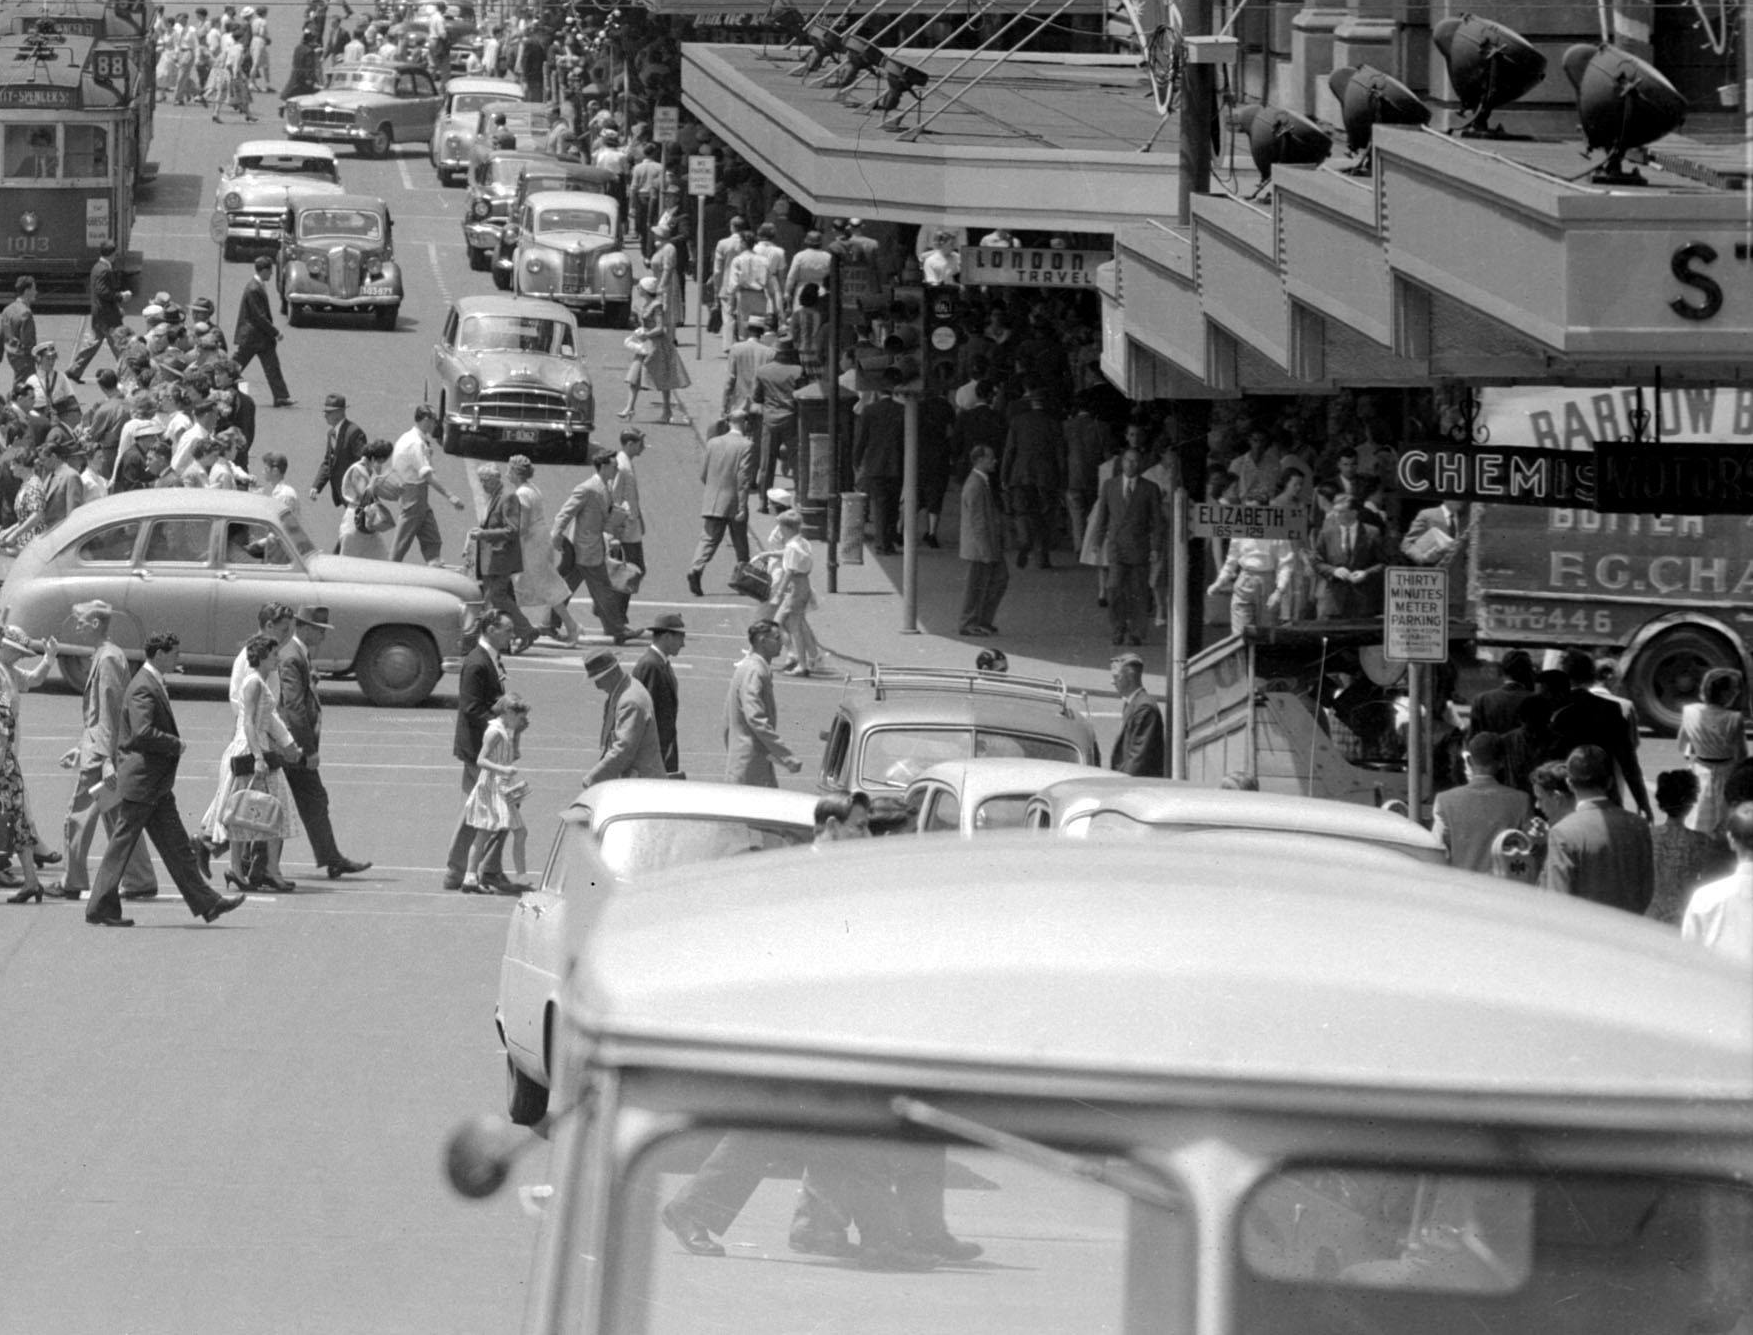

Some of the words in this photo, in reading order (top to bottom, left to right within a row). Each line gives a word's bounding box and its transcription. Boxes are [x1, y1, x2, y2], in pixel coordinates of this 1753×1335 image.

[97, 56, 124, 76] 88
[7, 236, 50, 252] 1013
[976, 250, 1084, 270] LONDON
[1199, 505, 1284, 527] ELIZABETH
[1395, 574, 1439, 586] THIRTY
[1390, 587, 1443, 600] MINUTES
[1395, 601, 1438, 613] METER
[1390, 614, 1442, 626] PARKING
